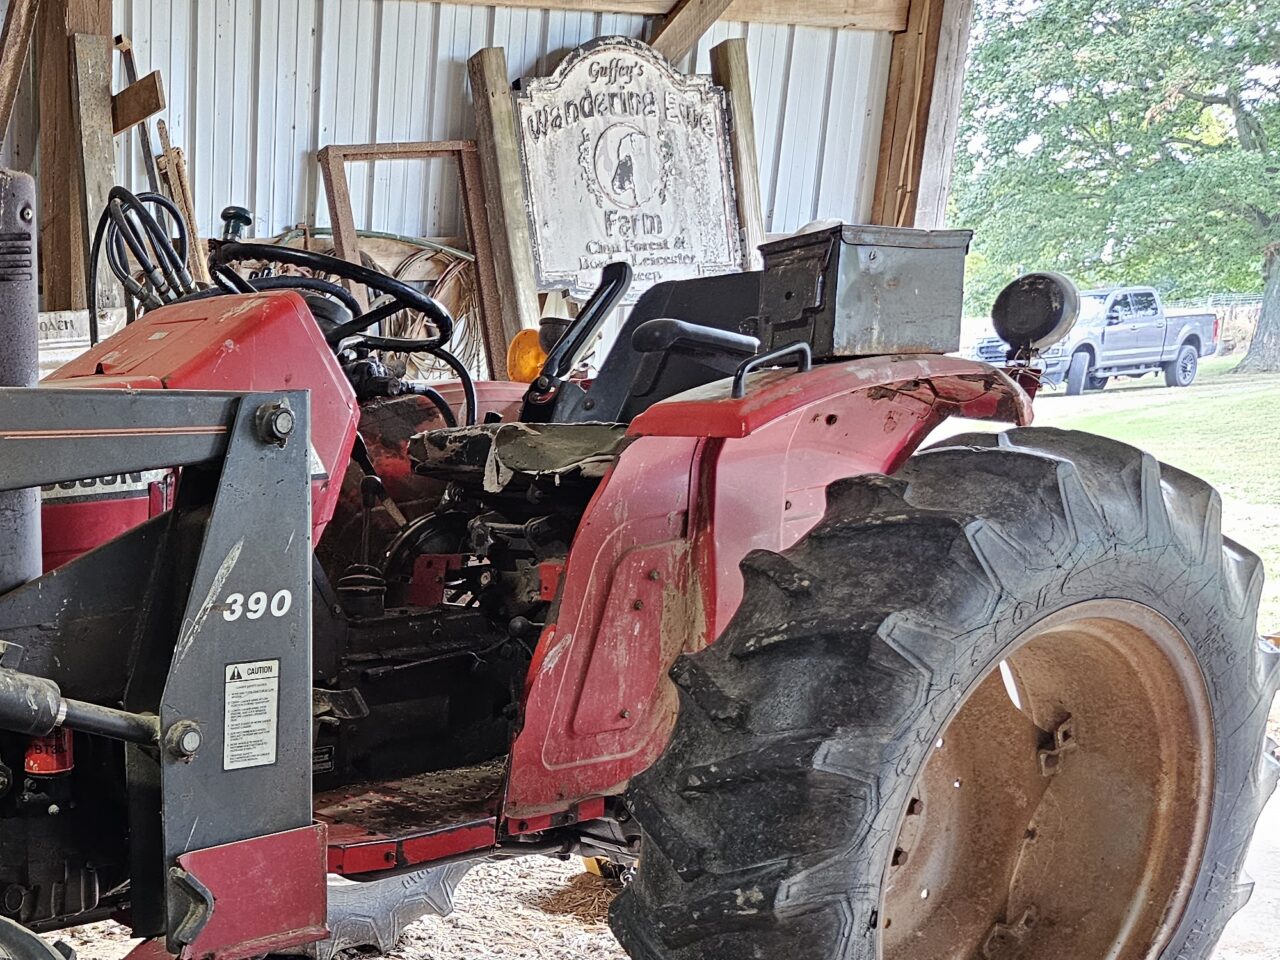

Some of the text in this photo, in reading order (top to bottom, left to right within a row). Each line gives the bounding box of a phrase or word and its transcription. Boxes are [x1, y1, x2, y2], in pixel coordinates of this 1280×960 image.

[588, 58, 644, 86] Guffey's
[527, 85, 716, 144] Wandering Ewe
[604, 209, 663, 237] Farm
[222, 589, 292, 622] 390
[246, 665, 273, 676] CAUTION
